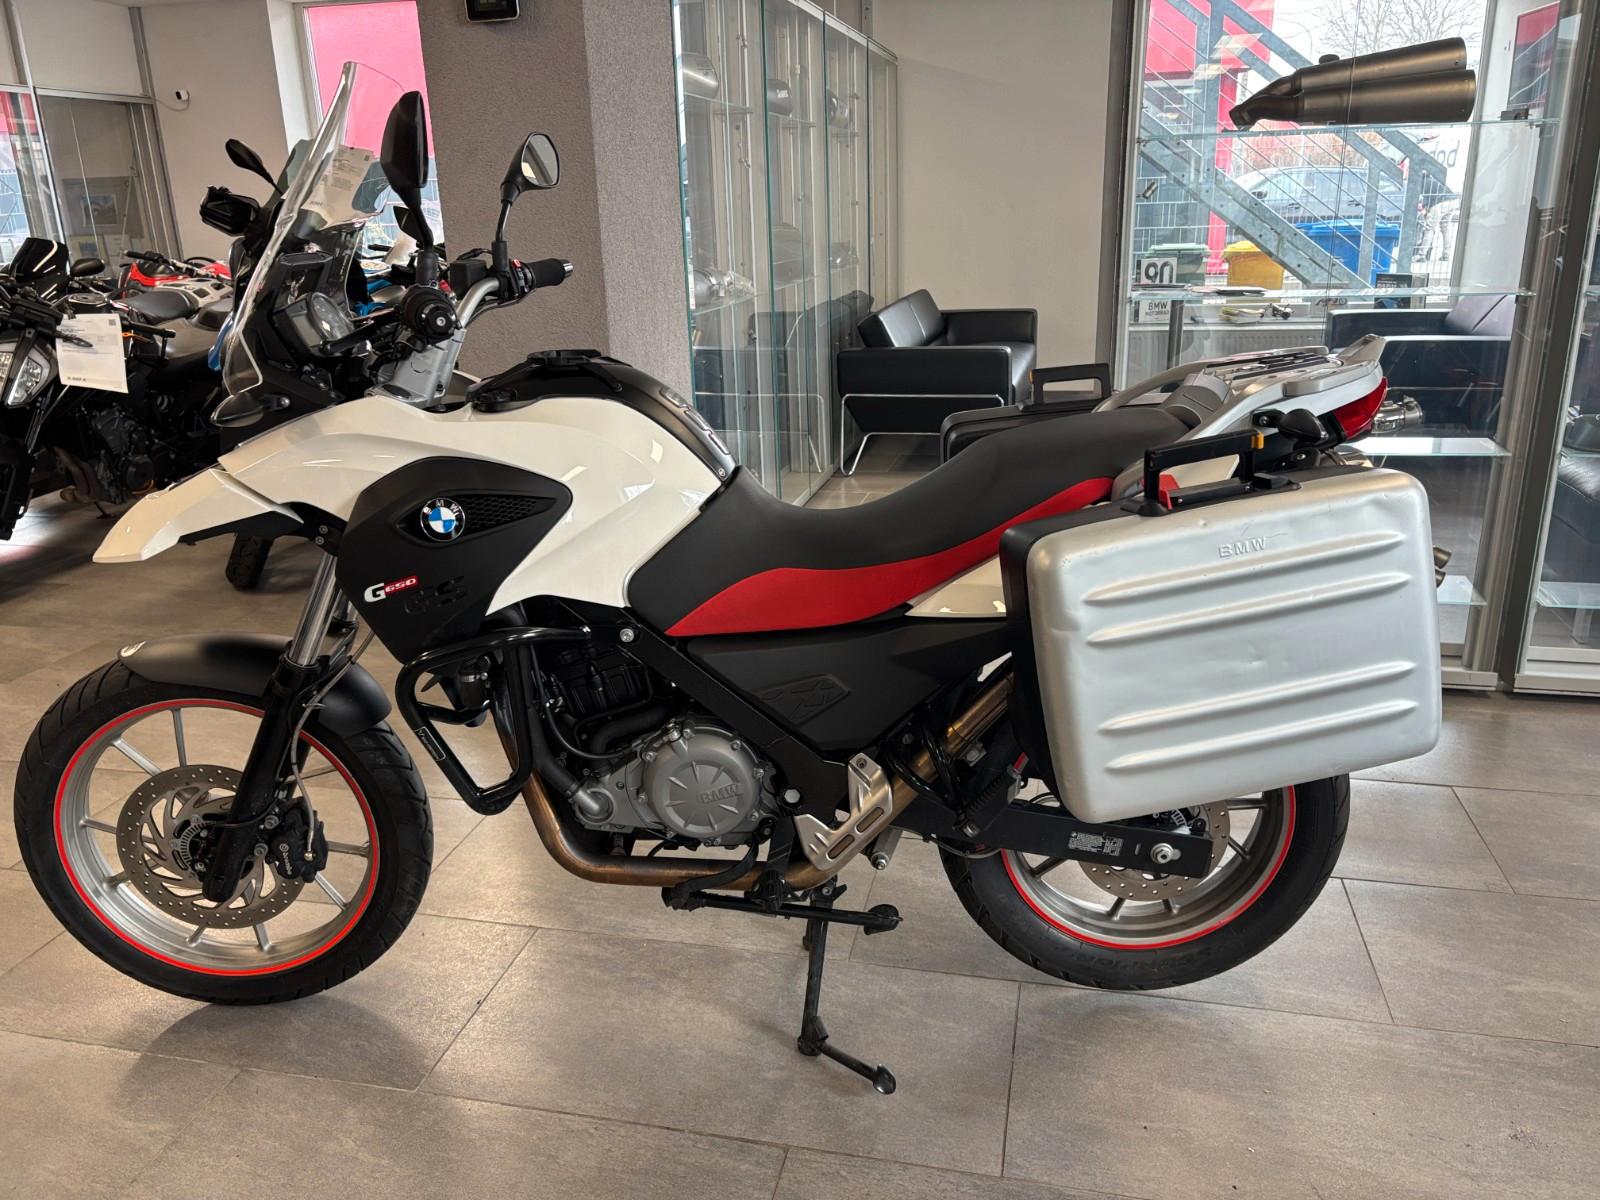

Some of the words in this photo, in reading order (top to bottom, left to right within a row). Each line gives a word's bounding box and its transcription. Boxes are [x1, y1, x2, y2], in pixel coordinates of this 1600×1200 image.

[1148, 301, 1168, 311] BMW
[423, 499, 461, 517] BMW
[1218, 535, 1266, 558] BMW
[700, 784, 738, 804] BMW
